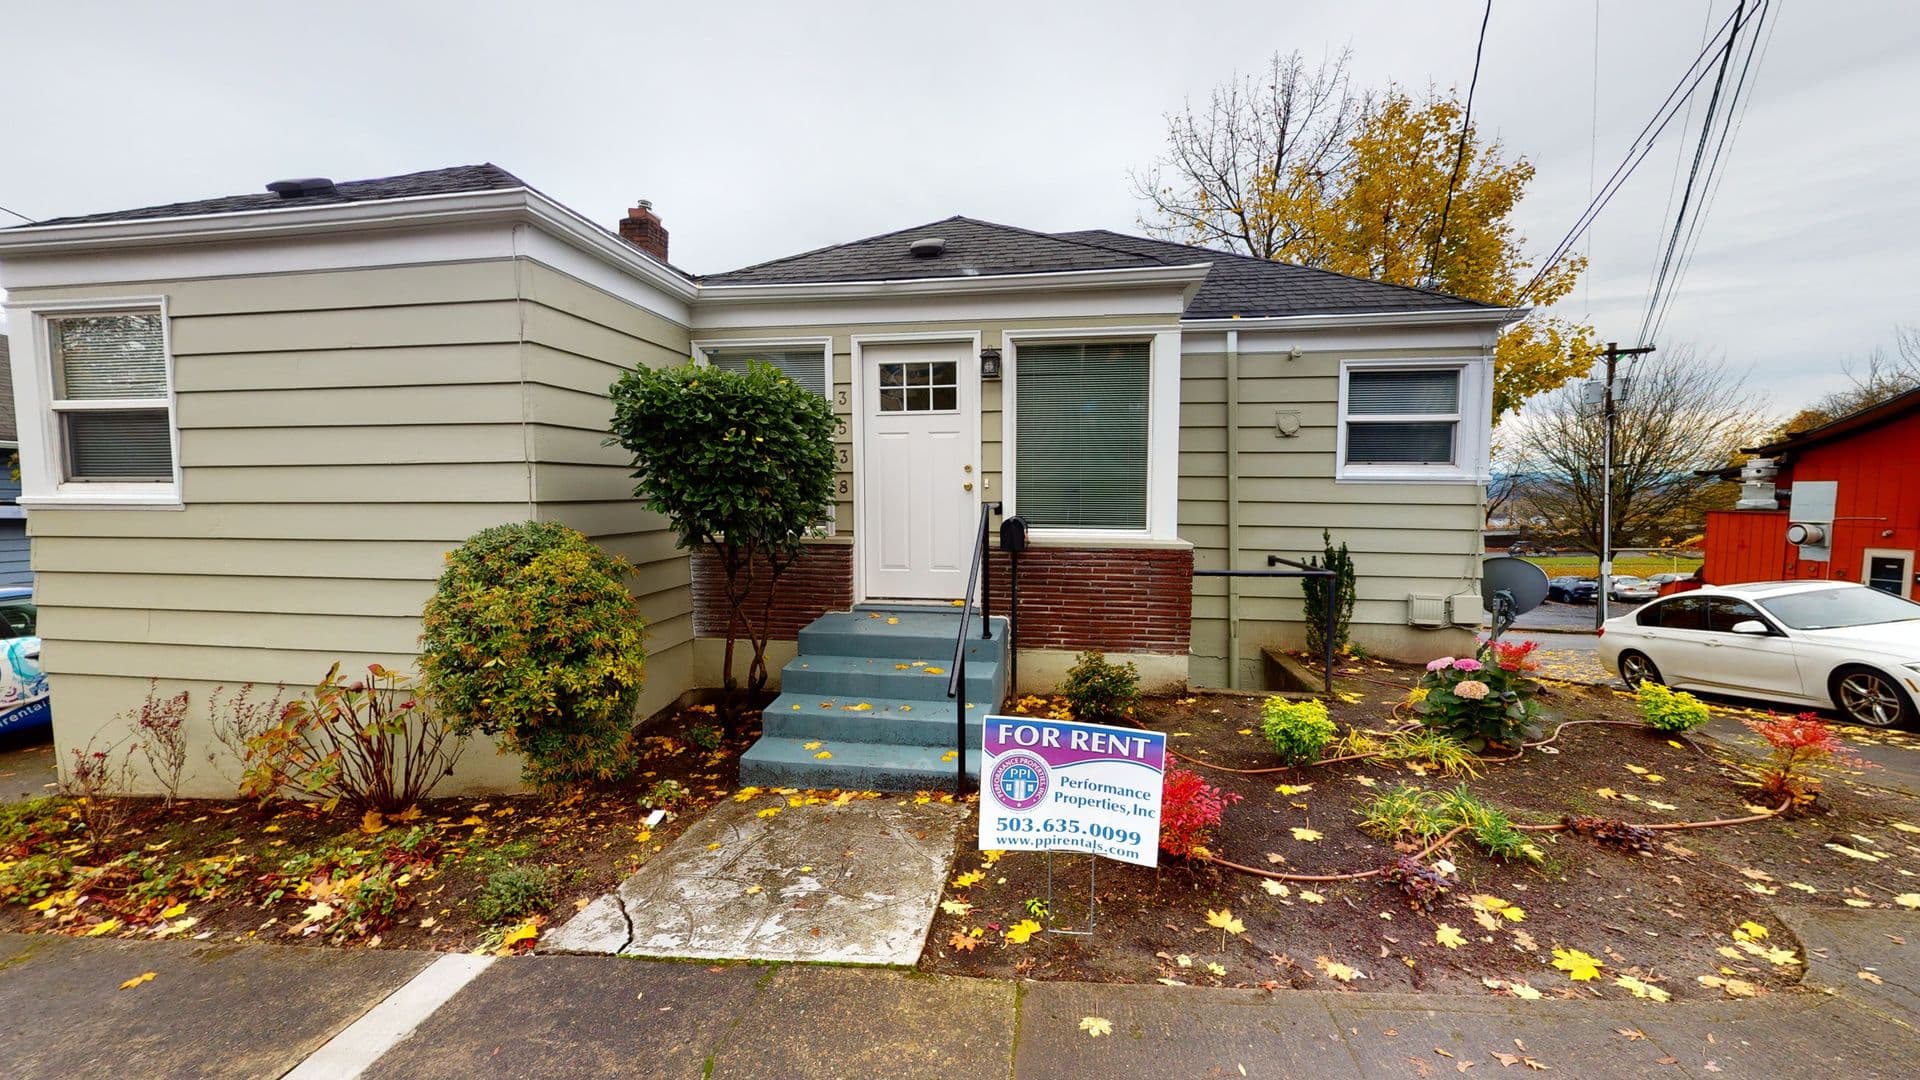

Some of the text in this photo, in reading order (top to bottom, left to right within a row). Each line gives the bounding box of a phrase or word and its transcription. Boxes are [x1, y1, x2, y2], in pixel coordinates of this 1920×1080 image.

[998, 724, 1151, 759] FOR RENT
[1010, 768, 1031, 779] PPI
[1060, 776, 1151, 801] Performance
[996, 817, 1142, 846] 503.635.0099
[996, 835, 1140, 860] www.ppirentals.com
